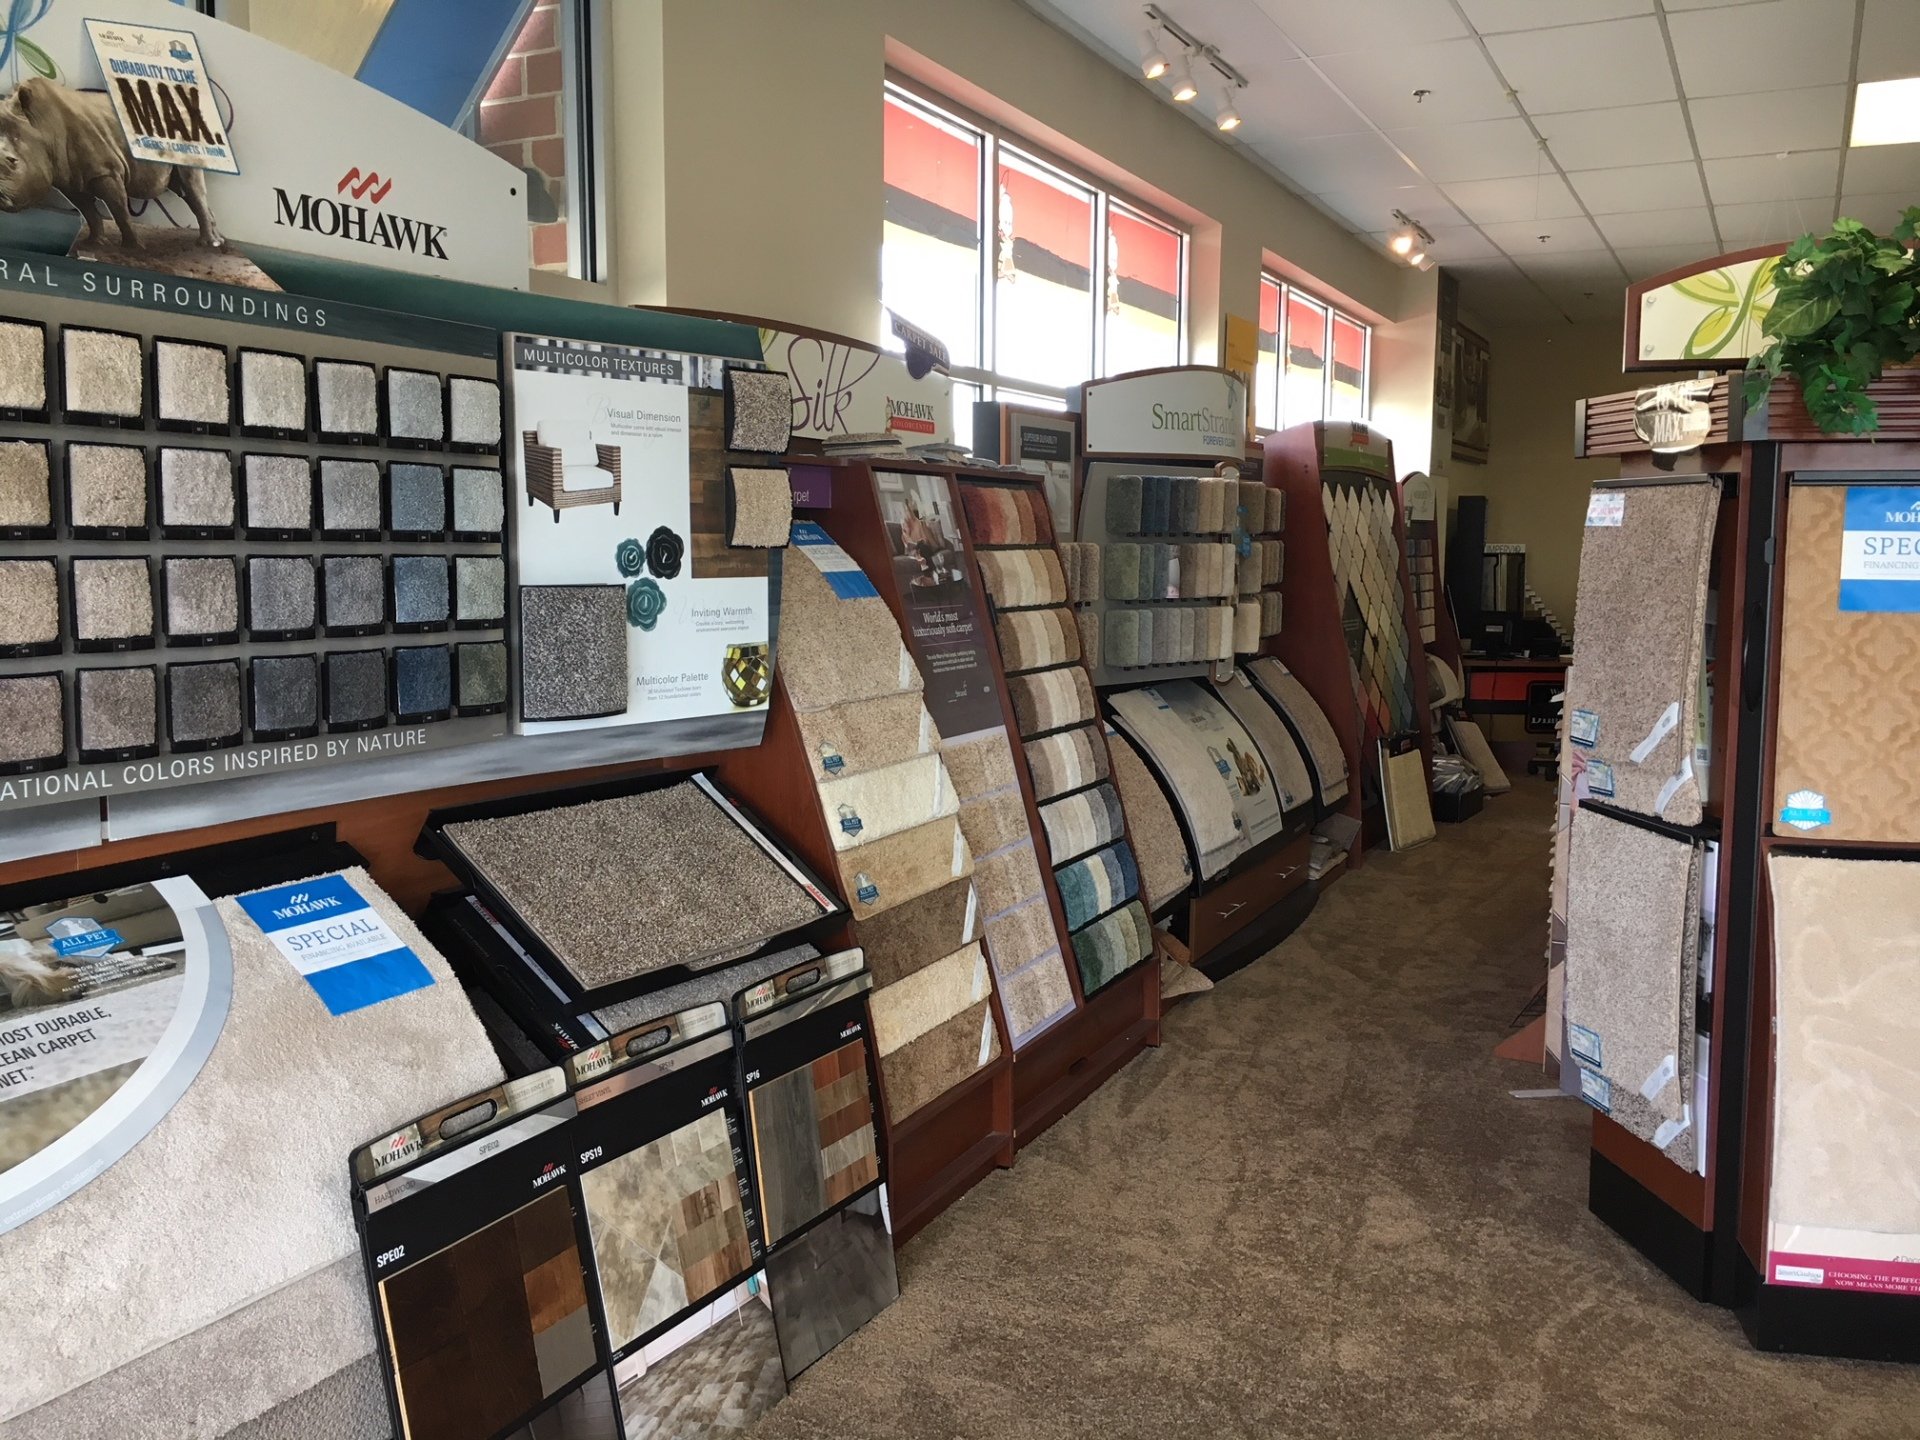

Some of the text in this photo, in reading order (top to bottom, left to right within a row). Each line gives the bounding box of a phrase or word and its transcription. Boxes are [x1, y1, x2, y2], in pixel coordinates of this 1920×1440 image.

[109, 58, 198, 85] DURABILITY TO THE
[115, 77, 225, 145] MAX.
[273, 187, 450, 261] MOHAWK
[83, 271, 328, 328] SURROUNDINGS
[523, 348, 675, 377] MULTICOLOR TEXTURES
[607, 408, 681, 423] Visual Dimension
[891, 399, 934, 421] MOHAWK
[1863, 560, 1919, 570] FINANCING
[691, 605, 753, 618] Inviting Warmth
[636, 672, 709, 686] Multicolor Palette
[0, 728, 427, 801] ATIONAL COLORS INSPIRED BY NATURE
[272, 896, 343, 919] MOHAWK
[61, 938, 85, 949] ALL
[86, 930, 109, 944] PET
[287, 918, 379, 951] SPECIAL
[300, 944, 346, 961] FINANCING
[35, 1006, 112, 1035] DURABLE,
[37, 1028, 97, 1055] CARPET
[575, 1055, 614, 1077] MOHAWK
[746, 1069, 760, 1083] SP16
[701, 1088, 728, 1108] MOHAWK
[374, 1138, 424, 1169] MOHAWK
[479, 1139, 500, 1156] SPE02
[580, 1145, 603, 1164] SPS19
[532, 1164, 566, 1189] MOHAWK
[374, 1179, 417, 1205] HARDWOOD
[376, 1244, 406, 1269] SPE02
[1828, 1271, 1872, 1281] CHOOSING
[1874, 1274, 1890, 1283] THE
[1835, 1279, 1853, 1287] NOW
[1855, 1281, 1883, 1289] MEANS
[1885, 1283, 1908, 1291] MORE
